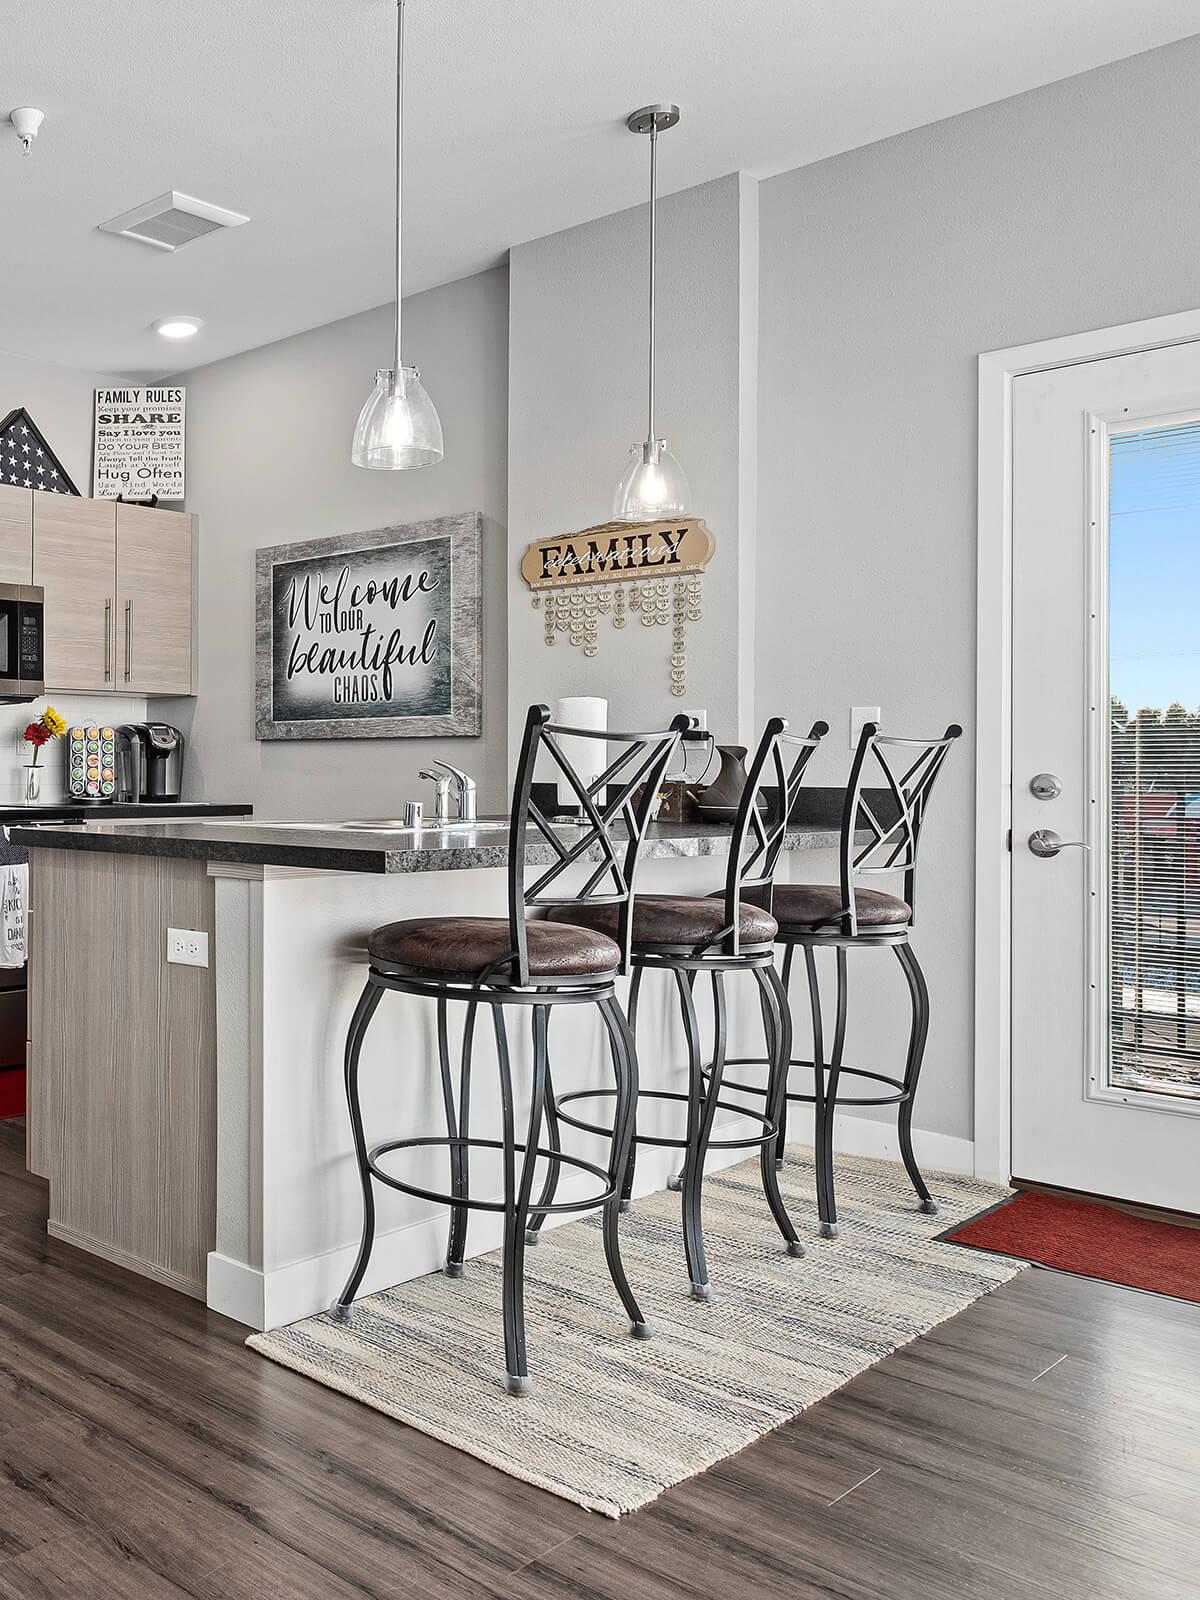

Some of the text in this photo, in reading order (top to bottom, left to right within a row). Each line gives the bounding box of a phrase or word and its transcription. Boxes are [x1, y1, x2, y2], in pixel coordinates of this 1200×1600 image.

[97, 390, 182, 404] FAMILY RULES
[143, 405, 182, 413] promises
[98, 413, 182, 425] SHARE
[98, 430, 121, 438] Say
[97, 443, 115, 451] DO
[97, 466, 182, 482] Hug Often
[539, 528, 689, 579] FAMILY
[544, 542, 680, 569] celebrations
[278, 565, 440, 634] Welcome
[319, 608, 364, 634] TO OUR
[287, 618, 438, 702] beautiful
